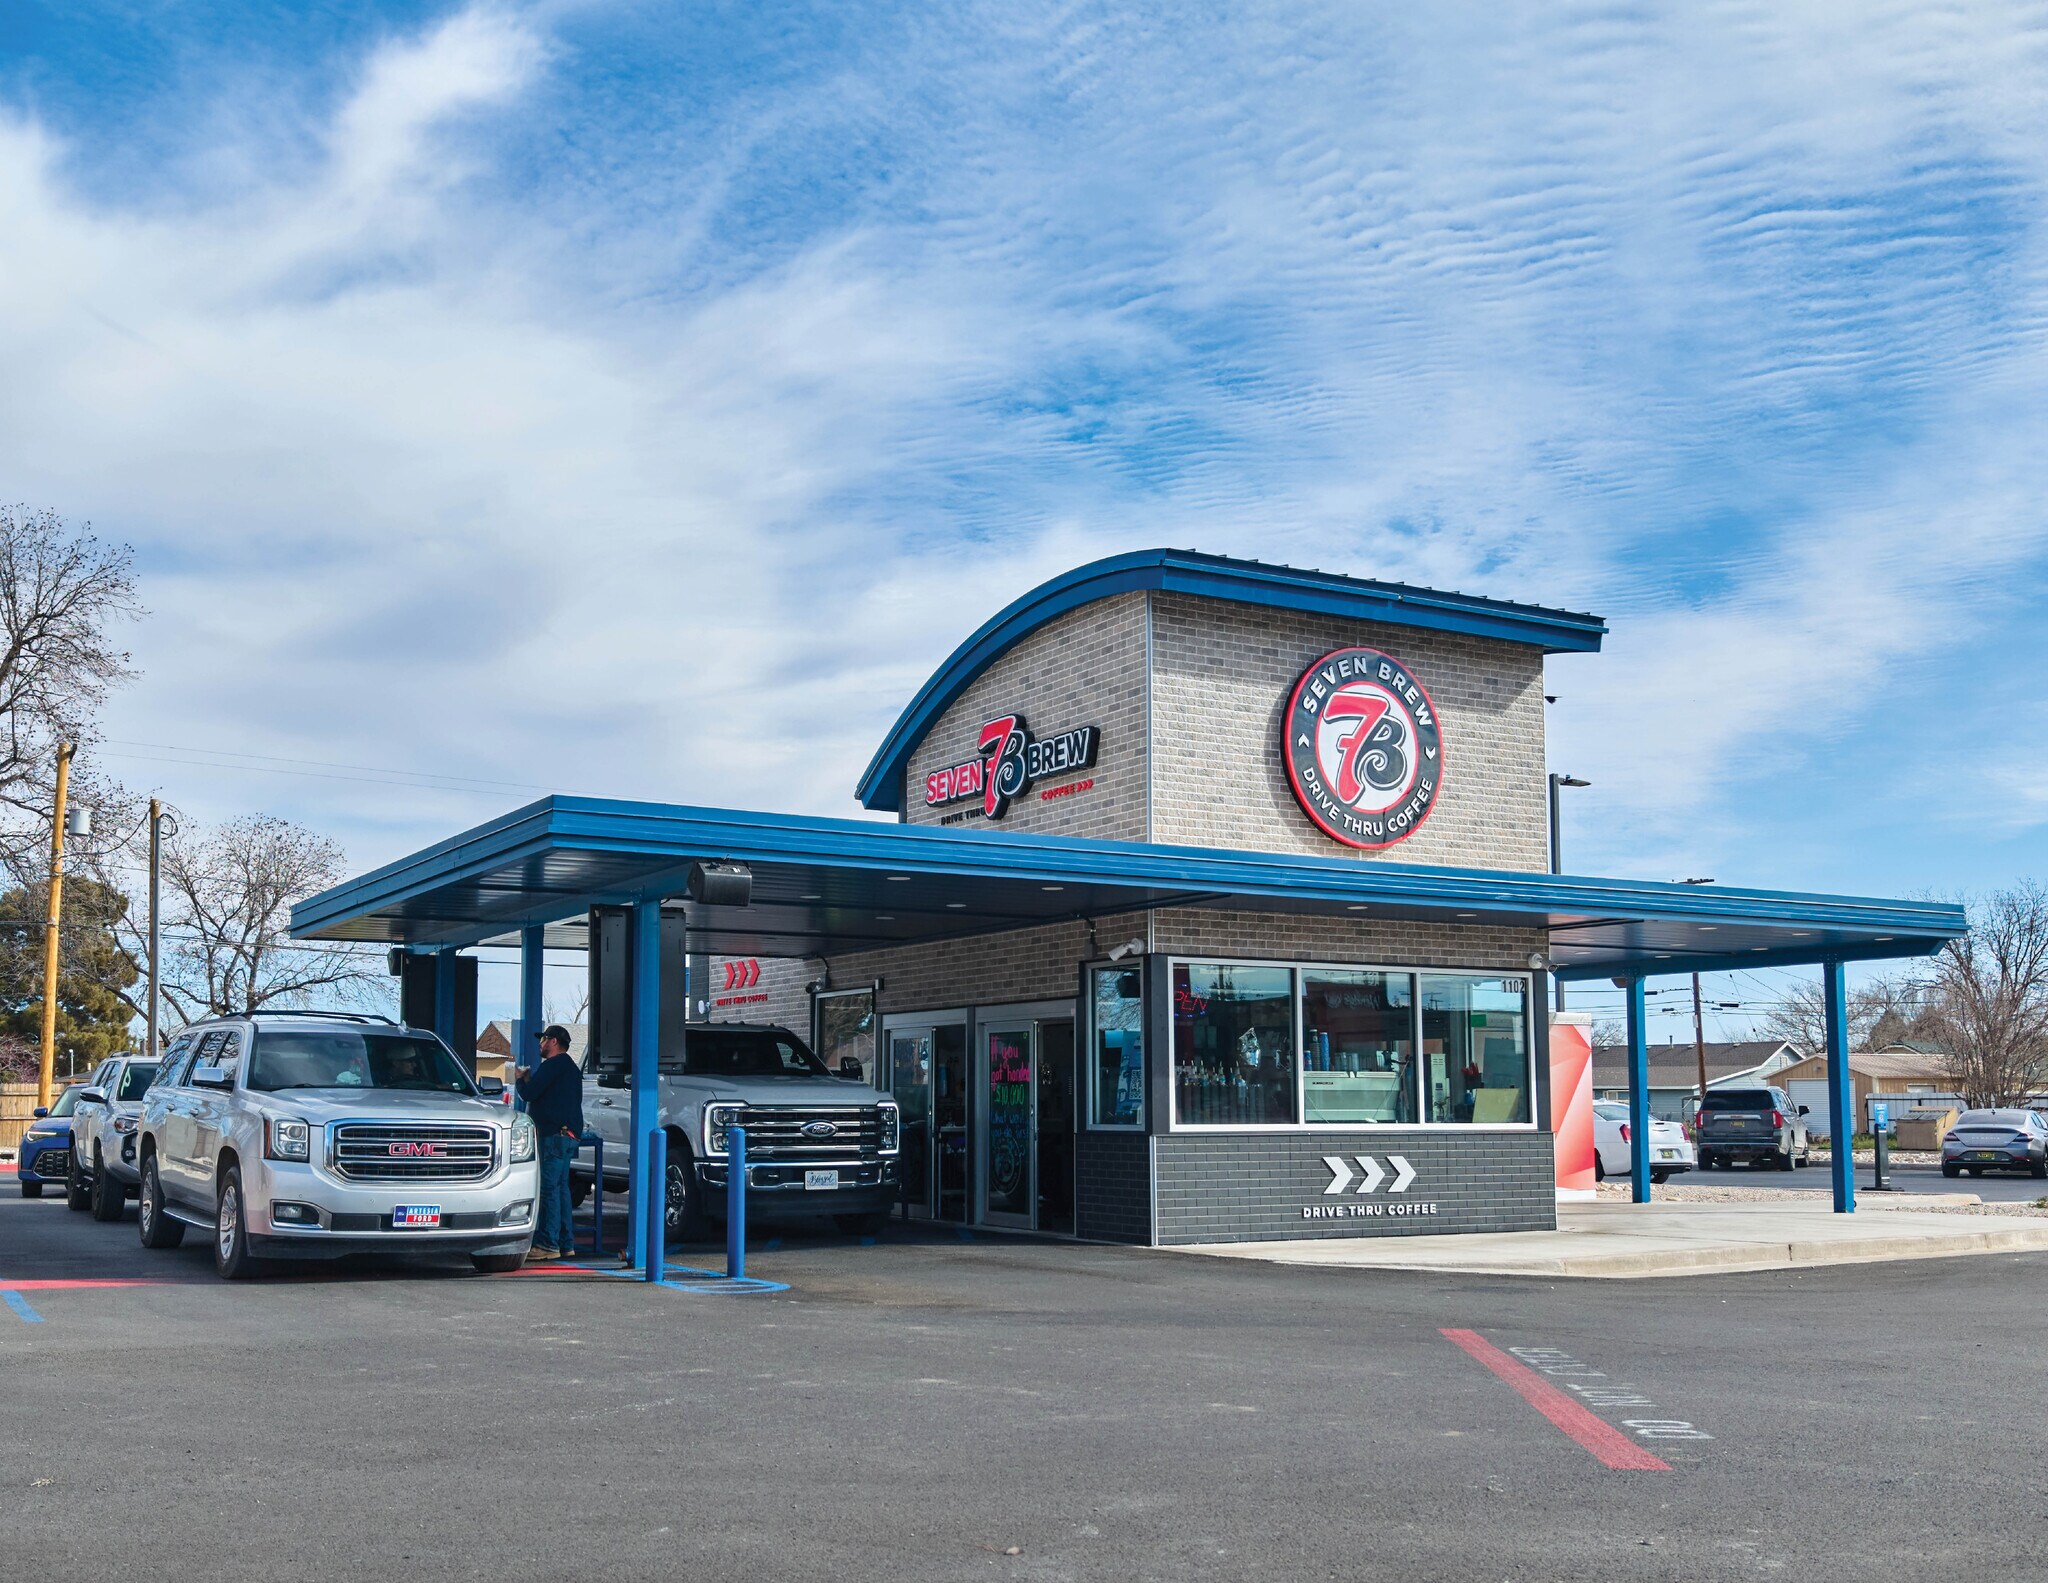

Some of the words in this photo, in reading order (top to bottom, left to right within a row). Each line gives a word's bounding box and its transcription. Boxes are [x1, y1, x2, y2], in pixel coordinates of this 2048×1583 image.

[1302, 657, 1367, 714] SEVEN
[1377, 661, 1433, 727] BREW
[926, 760, 983, 804] SEVEN
[1028, 727, 1090, 777] BREW
[1041, 783, 1075, 800] COFFEE
[1303, 767, 1341, 821] DRIVE
[1343, 813, 1383, 836] THRU
[1387, 777, 1433, 832] COFFEE
[941, 811, 963, 825] DRIVE
[965, 806, 986, 819] THRU
[1502, 980, 1525, 993] 1102
[1174, 990, 1208, 1010] PEN
[1001, 1046, 1018, 1068] you
[811, 1124, 829, 1133] Ford
[389, 1143, 448, 1157] GMC
[1303, 1206, 1343, 1218] DRIVE
[1349, 1205, 1382, 1216] THRU
[1388, 1203, 1437, 1215] COFFEE
[1566, 1383, 1657, 1407] NOT
[1621, 1419, 1716, 1439] DO
